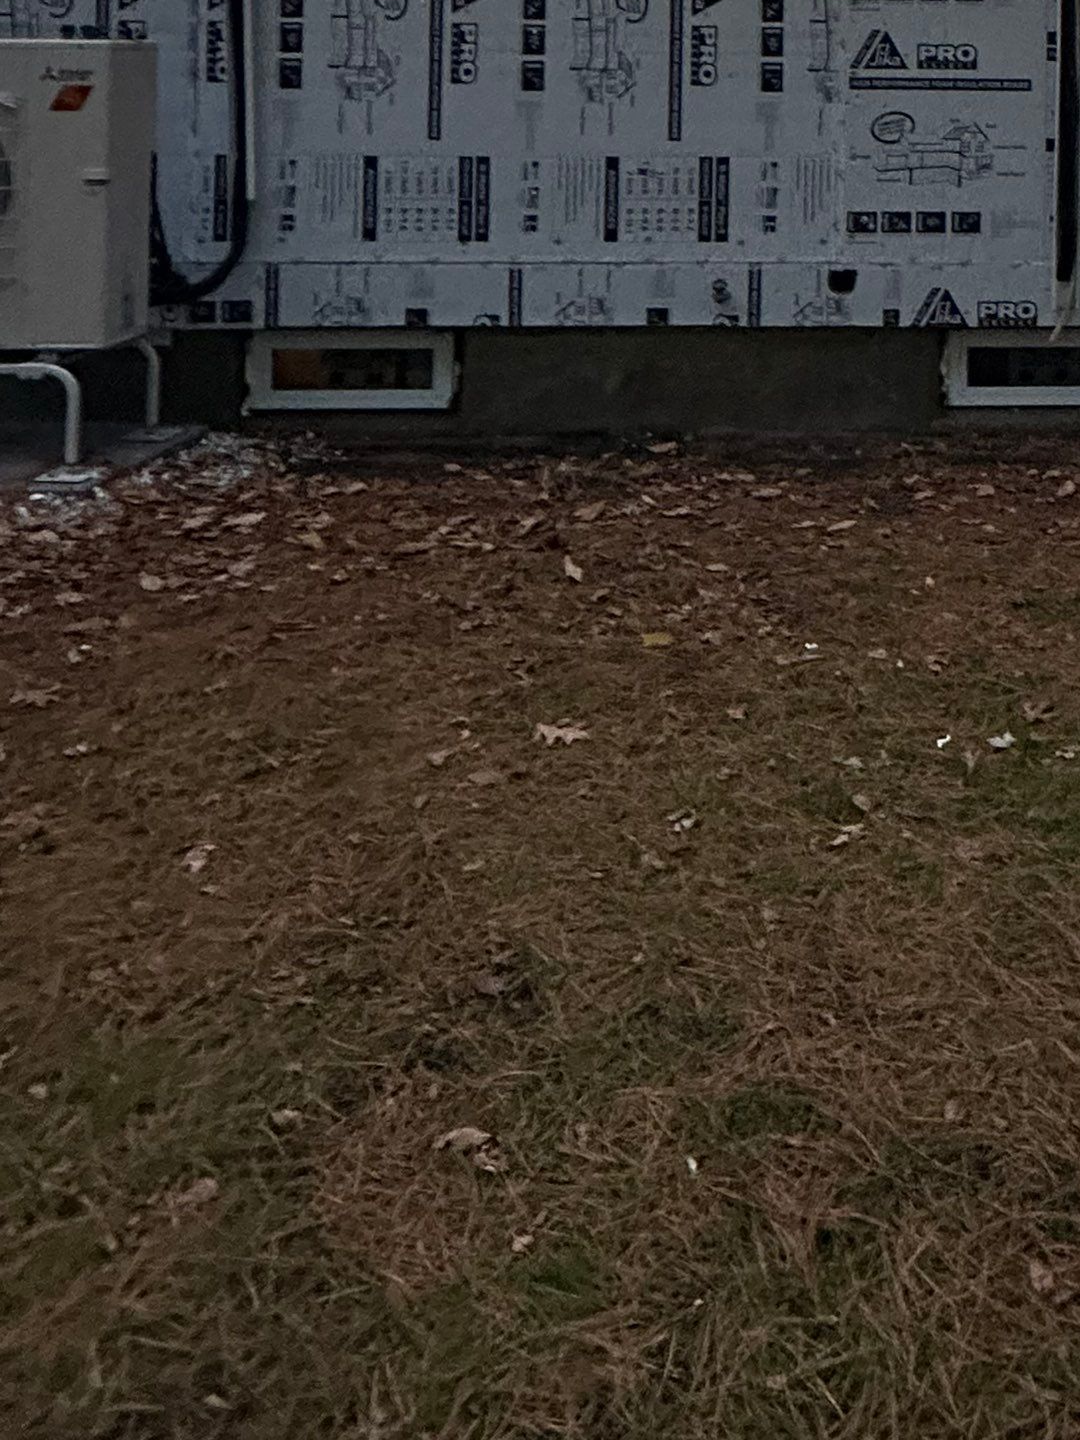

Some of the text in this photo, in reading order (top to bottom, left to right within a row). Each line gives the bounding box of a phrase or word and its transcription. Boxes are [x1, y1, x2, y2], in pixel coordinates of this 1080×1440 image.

[459, 23, 476, 84] PRO
[699, 26, 716, 85] PRO
[918, 44, 977, 62] PRO
[979, 302, 1037, 320] PRO
